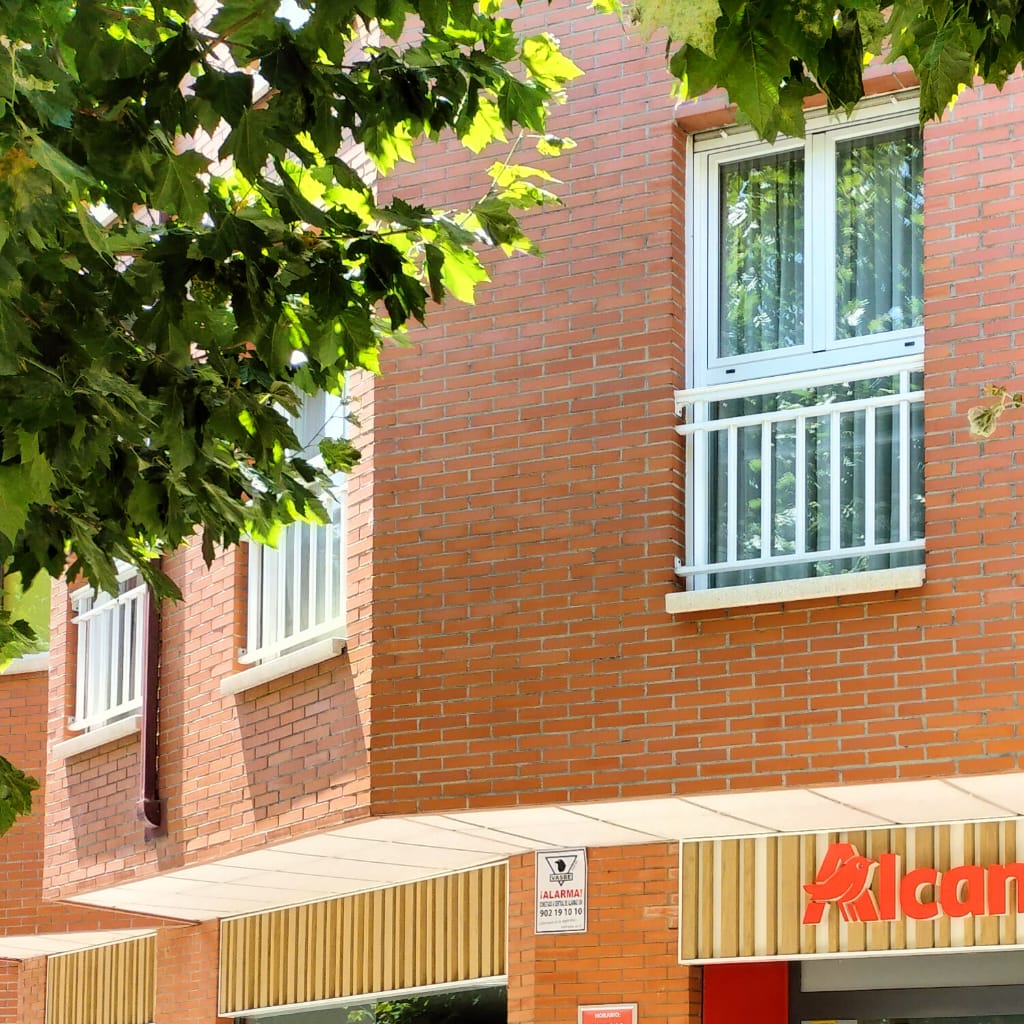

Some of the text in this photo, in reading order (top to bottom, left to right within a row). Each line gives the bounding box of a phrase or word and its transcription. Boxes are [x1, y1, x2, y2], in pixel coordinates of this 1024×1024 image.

[540, 907, 582, 917] 902 19 10 10
